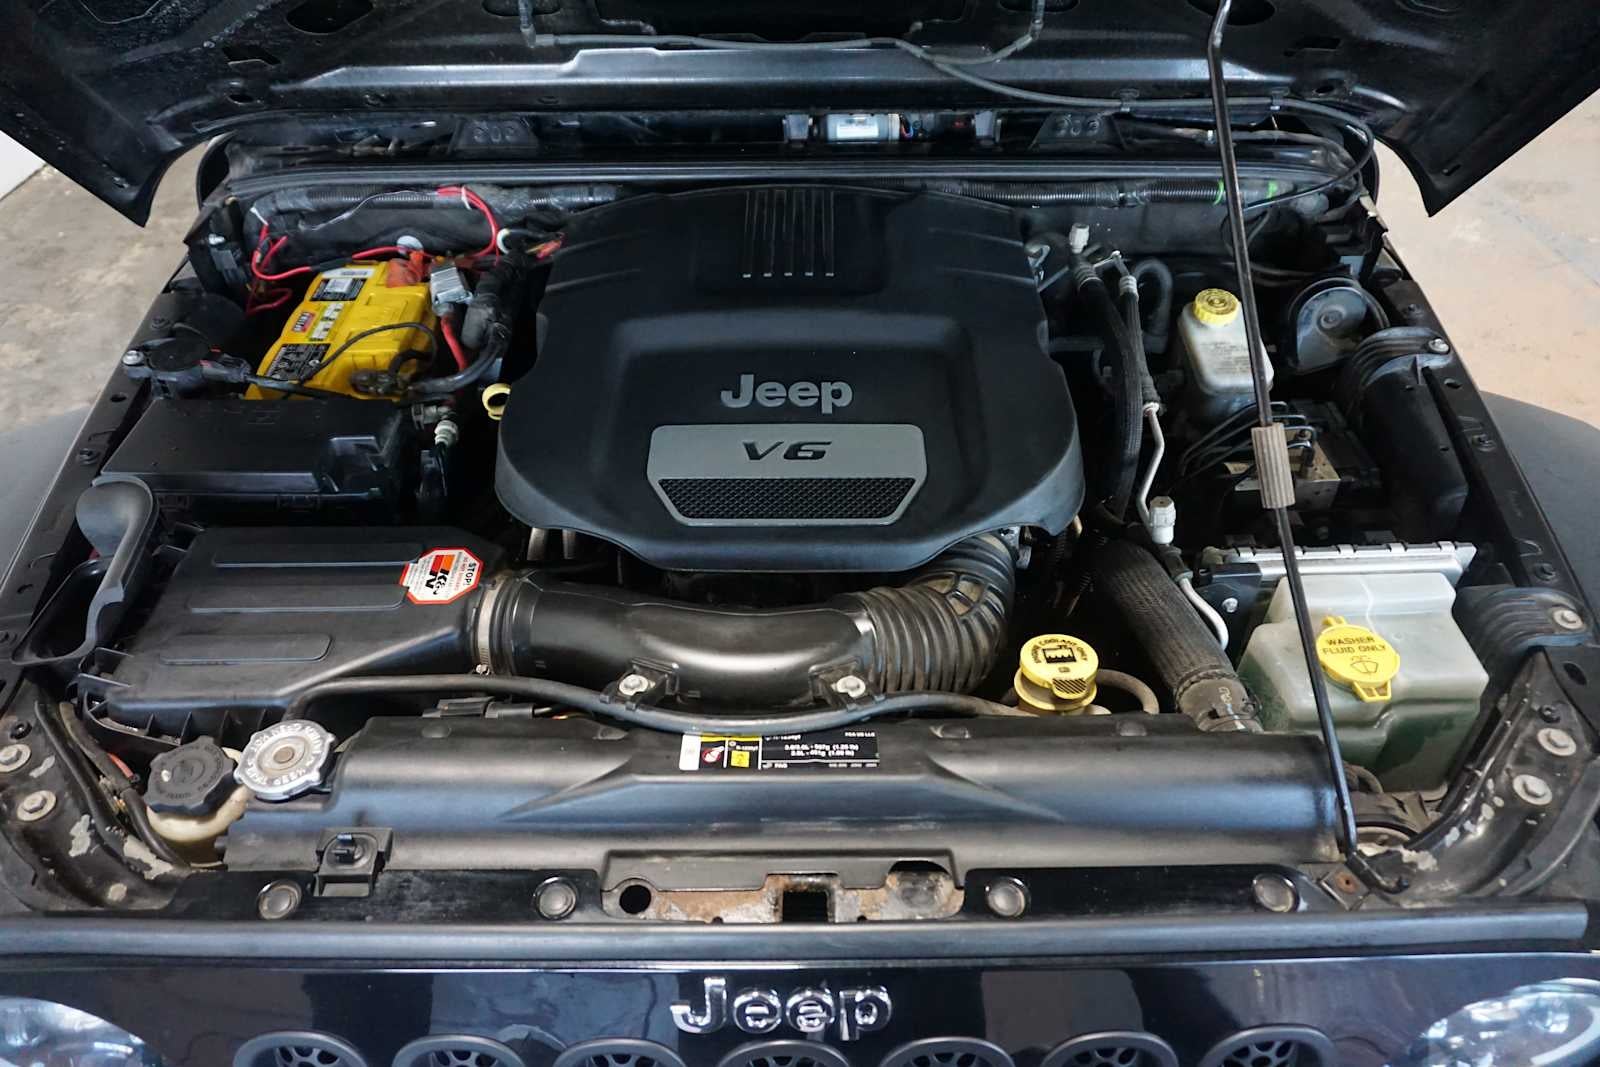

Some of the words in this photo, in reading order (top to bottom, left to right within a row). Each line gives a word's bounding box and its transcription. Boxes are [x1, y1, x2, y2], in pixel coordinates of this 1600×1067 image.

[720, 374, 853, 414] Jeep
[742, 441, 832, 461] V6
[1322, 646, 1356, 655] FLUID
[1358, 644, 1387, 653] ONLY
[1326, 636, 1376, 646] WASHER
[670, 977, 893, 1041] Jeep
